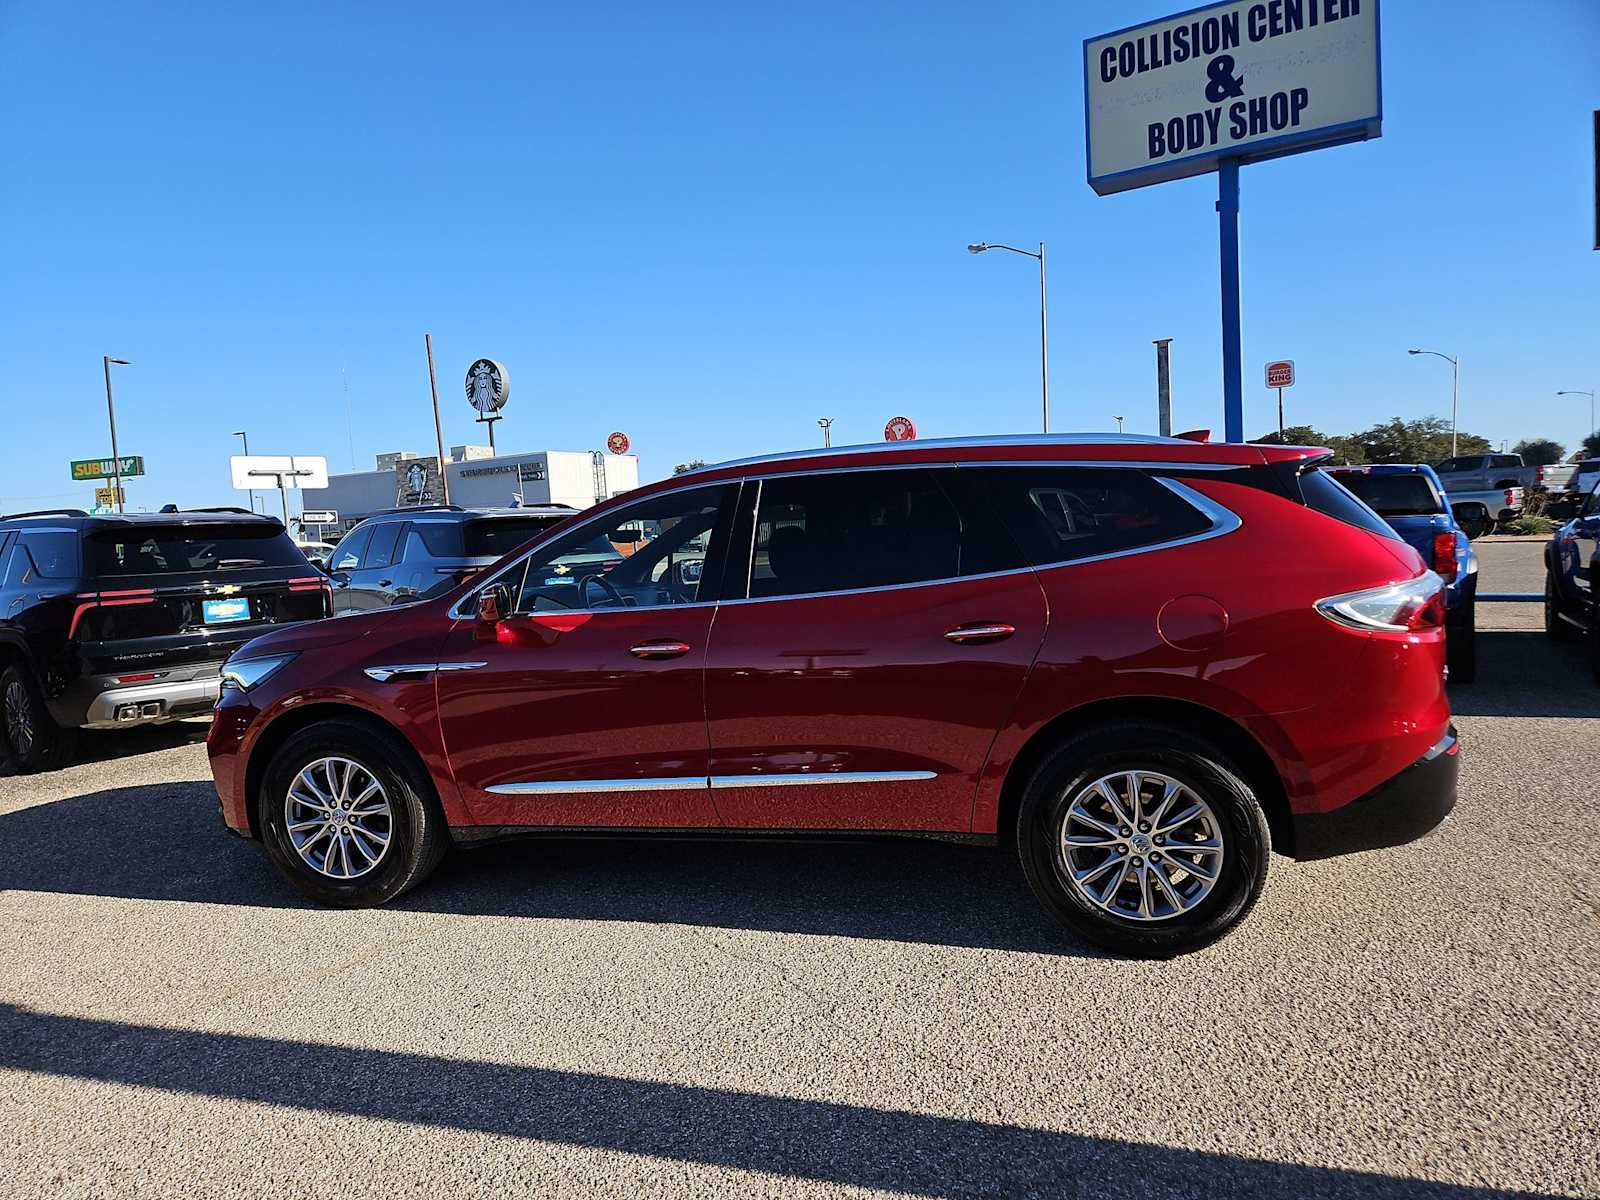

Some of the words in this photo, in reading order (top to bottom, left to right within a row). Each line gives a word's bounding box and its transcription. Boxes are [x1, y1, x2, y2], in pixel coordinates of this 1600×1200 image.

[1100, 12, 1240, 83] COLLISION
[1205, 54, 1244, 103] &
[1148, 107, 1222, 159] BODY
[1229, 88, 1309, 140] SHOP
[1268, 374, 1291, 382] KING
